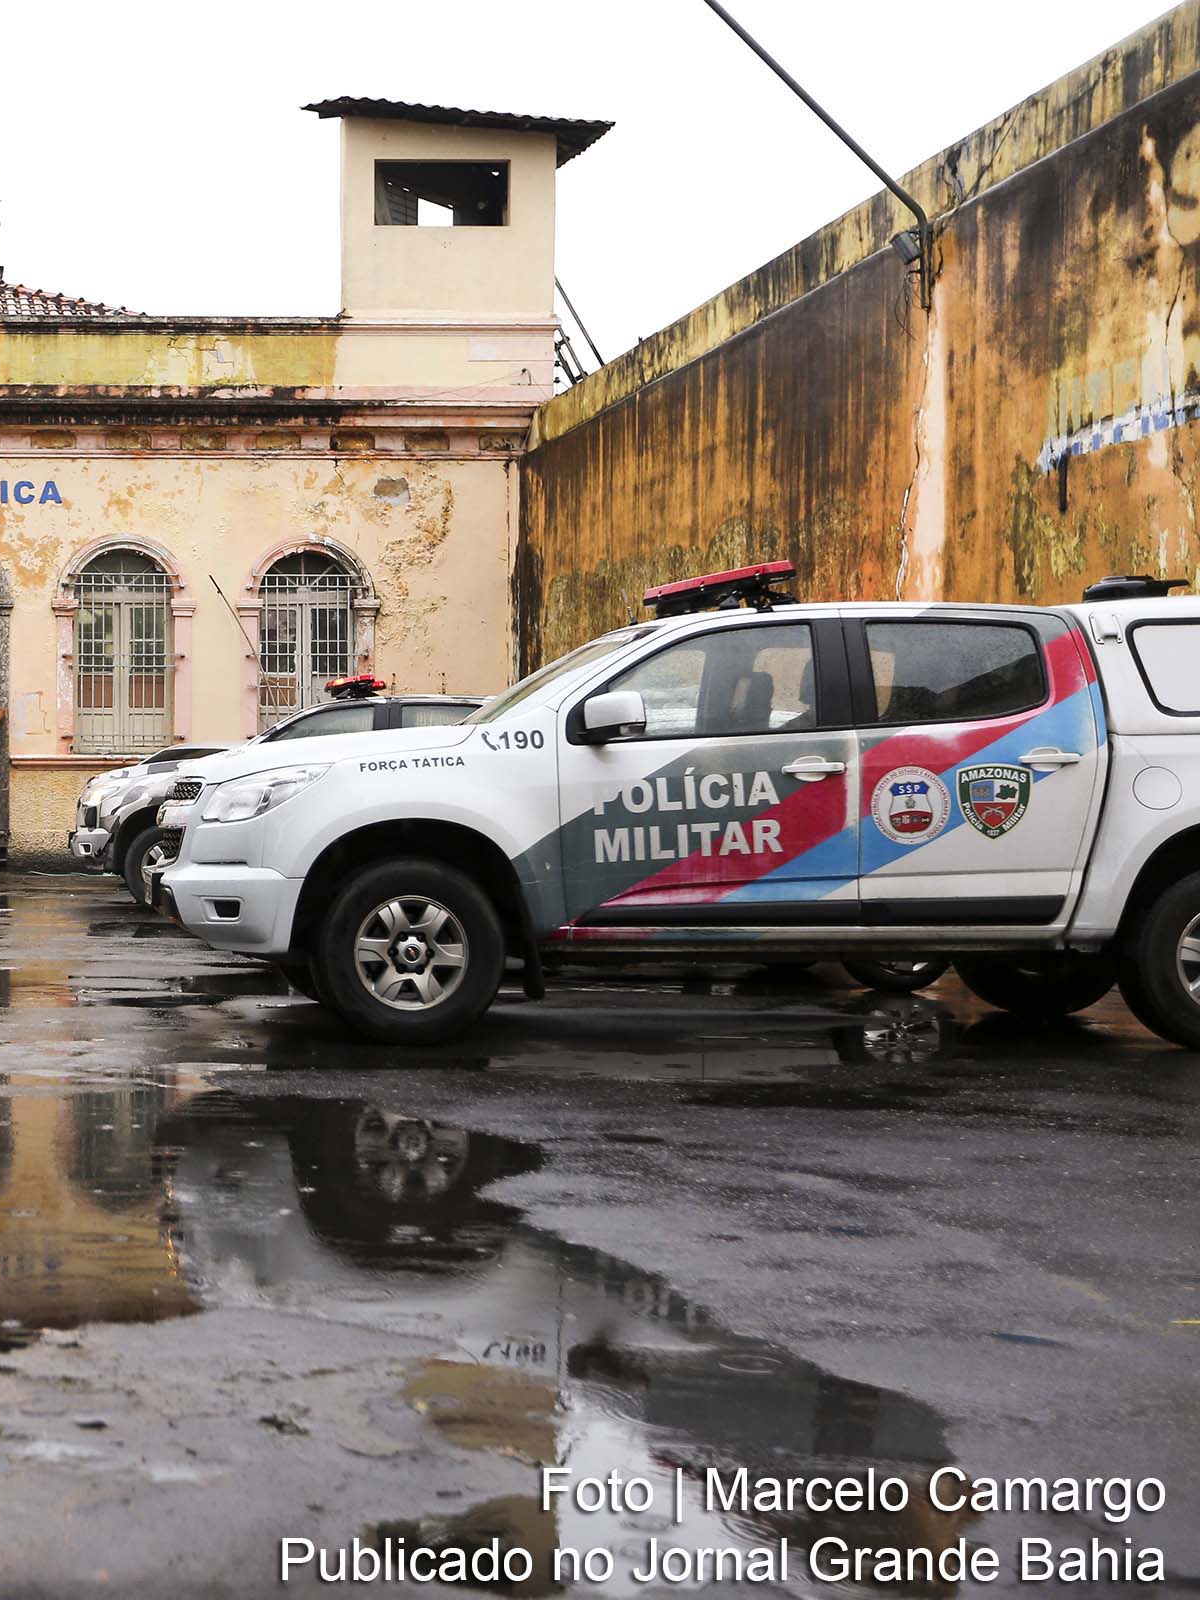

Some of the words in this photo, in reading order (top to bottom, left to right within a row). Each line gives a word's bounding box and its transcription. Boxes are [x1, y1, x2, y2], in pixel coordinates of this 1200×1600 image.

[499, 730, 544, 750] 190
[359, 759, 408, 772] FORÇA
[961, 768, 1027, 783] AMAZONAS
[898, 784, 920, 794] SSP
[1002, 804, 1026, 831] Militar
[594, 819, 784, 863] MILITAR
